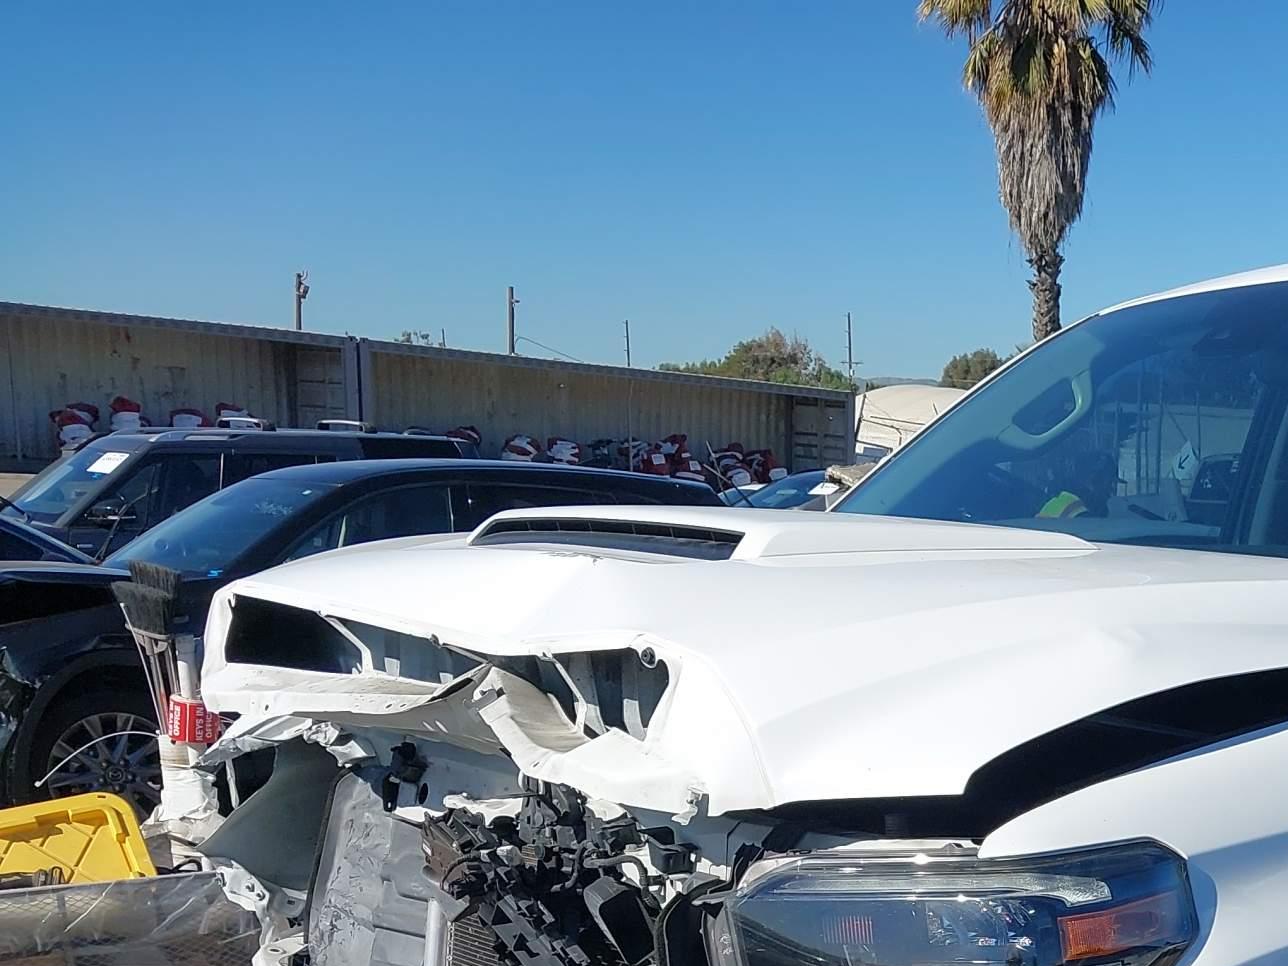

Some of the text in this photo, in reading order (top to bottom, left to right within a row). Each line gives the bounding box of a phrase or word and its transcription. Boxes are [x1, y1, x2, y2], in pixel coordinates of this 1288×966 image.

[173, 705, 181, 737] OFFICE
[195, 706, 204, 741] KEYS IN
